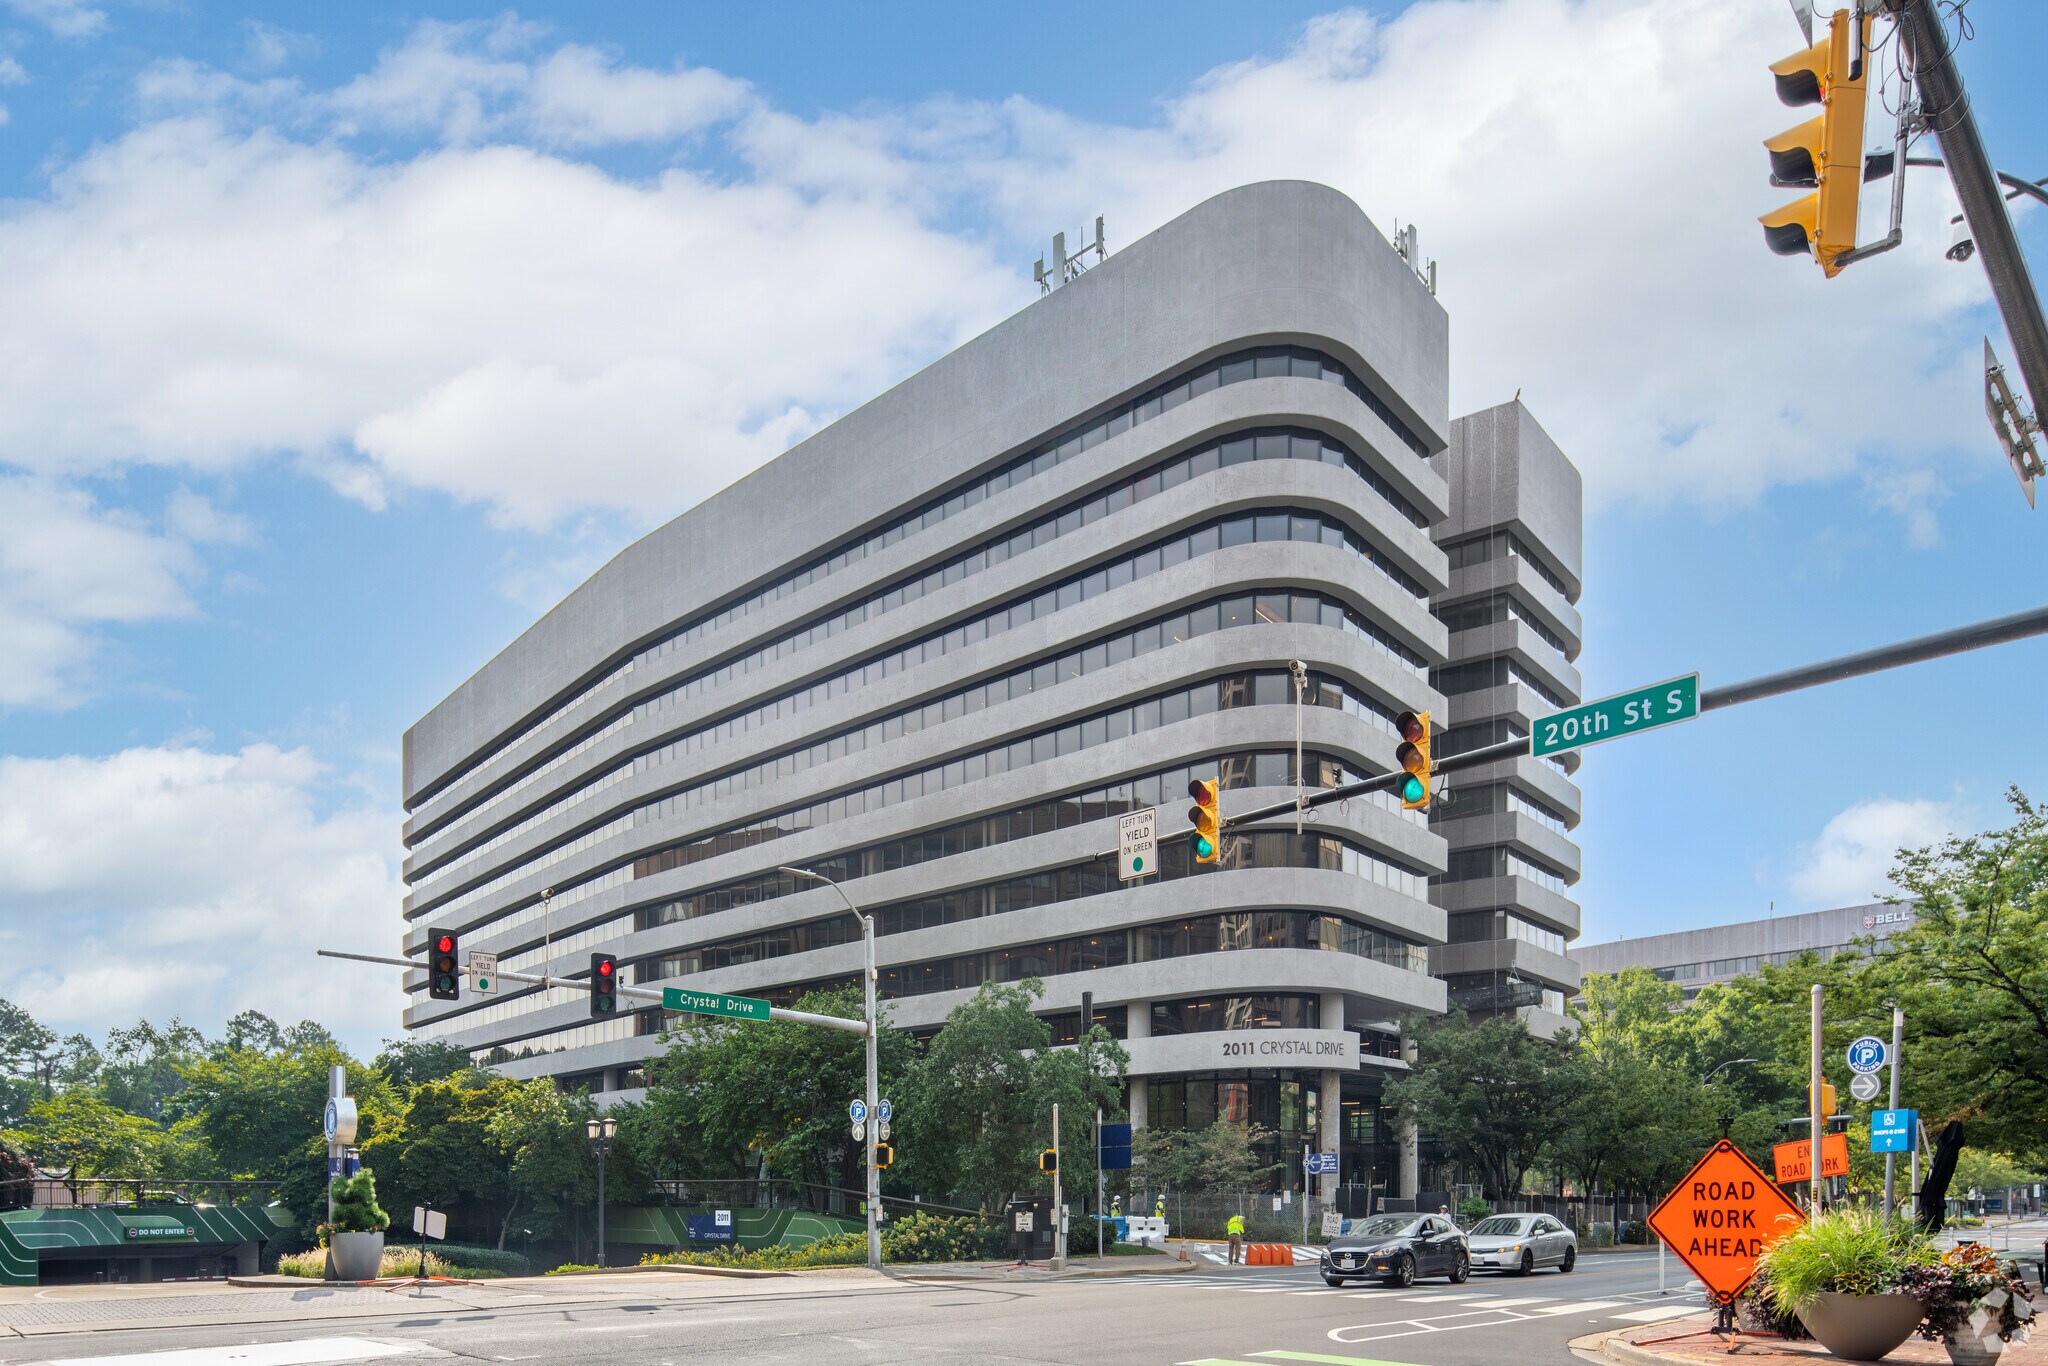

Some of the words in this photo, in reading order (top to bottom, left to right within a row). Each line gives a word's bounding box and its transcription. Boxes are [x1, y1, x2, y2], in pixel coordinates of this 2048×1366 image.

[1544, 711, 1609, 746] 20th
[1623, 699, 1652, 725] St
[1666, 689, 1683, 714] S
[1122, 817, 1136, 828] LEFT
[1137, 813, 1153, 824] TURN
[1126, 827, 1150, 841] YIELD
[1123, 846, 1132, 856] ON
[1134, 841, 1153, 853] GREEN
[1875, 911, 1910, 924] BELL
[476, 962, 491, 970] YIELD
[680, 993, 720, 1009] Crystal
[727, 999, 754, 1013] Drive
[1222, 1042, 1254, 1056] 2011
[1260, 1041, 1313, 1055] CRYSTAL
[1316, 1041, 1345, 1056] DRIVE
[1854, 1040, 1880, 1050] PUBLIC
[1861, 1048, 1875, 1064] P
[1852, 1061, 1881, 1072] PARKING
[855, 1107, 862, 1117] P
[882, 1107, 888, 1117] P
[1797, 1144, 1810, 1159] EN
[1781, 1162, 1806, 1178] ROAD
[1693, 1181, 1755, 1201] ROAD
[717, 1213, 729, 1222] 2011
[1326, 1215, 1339, 1224] ROAD
[1693, 1210, 1756, 1229] WORK
[1323, 1225, 1340, 1235] CLOSED
[1688, 1238, 1763, 1258] AHEAD
